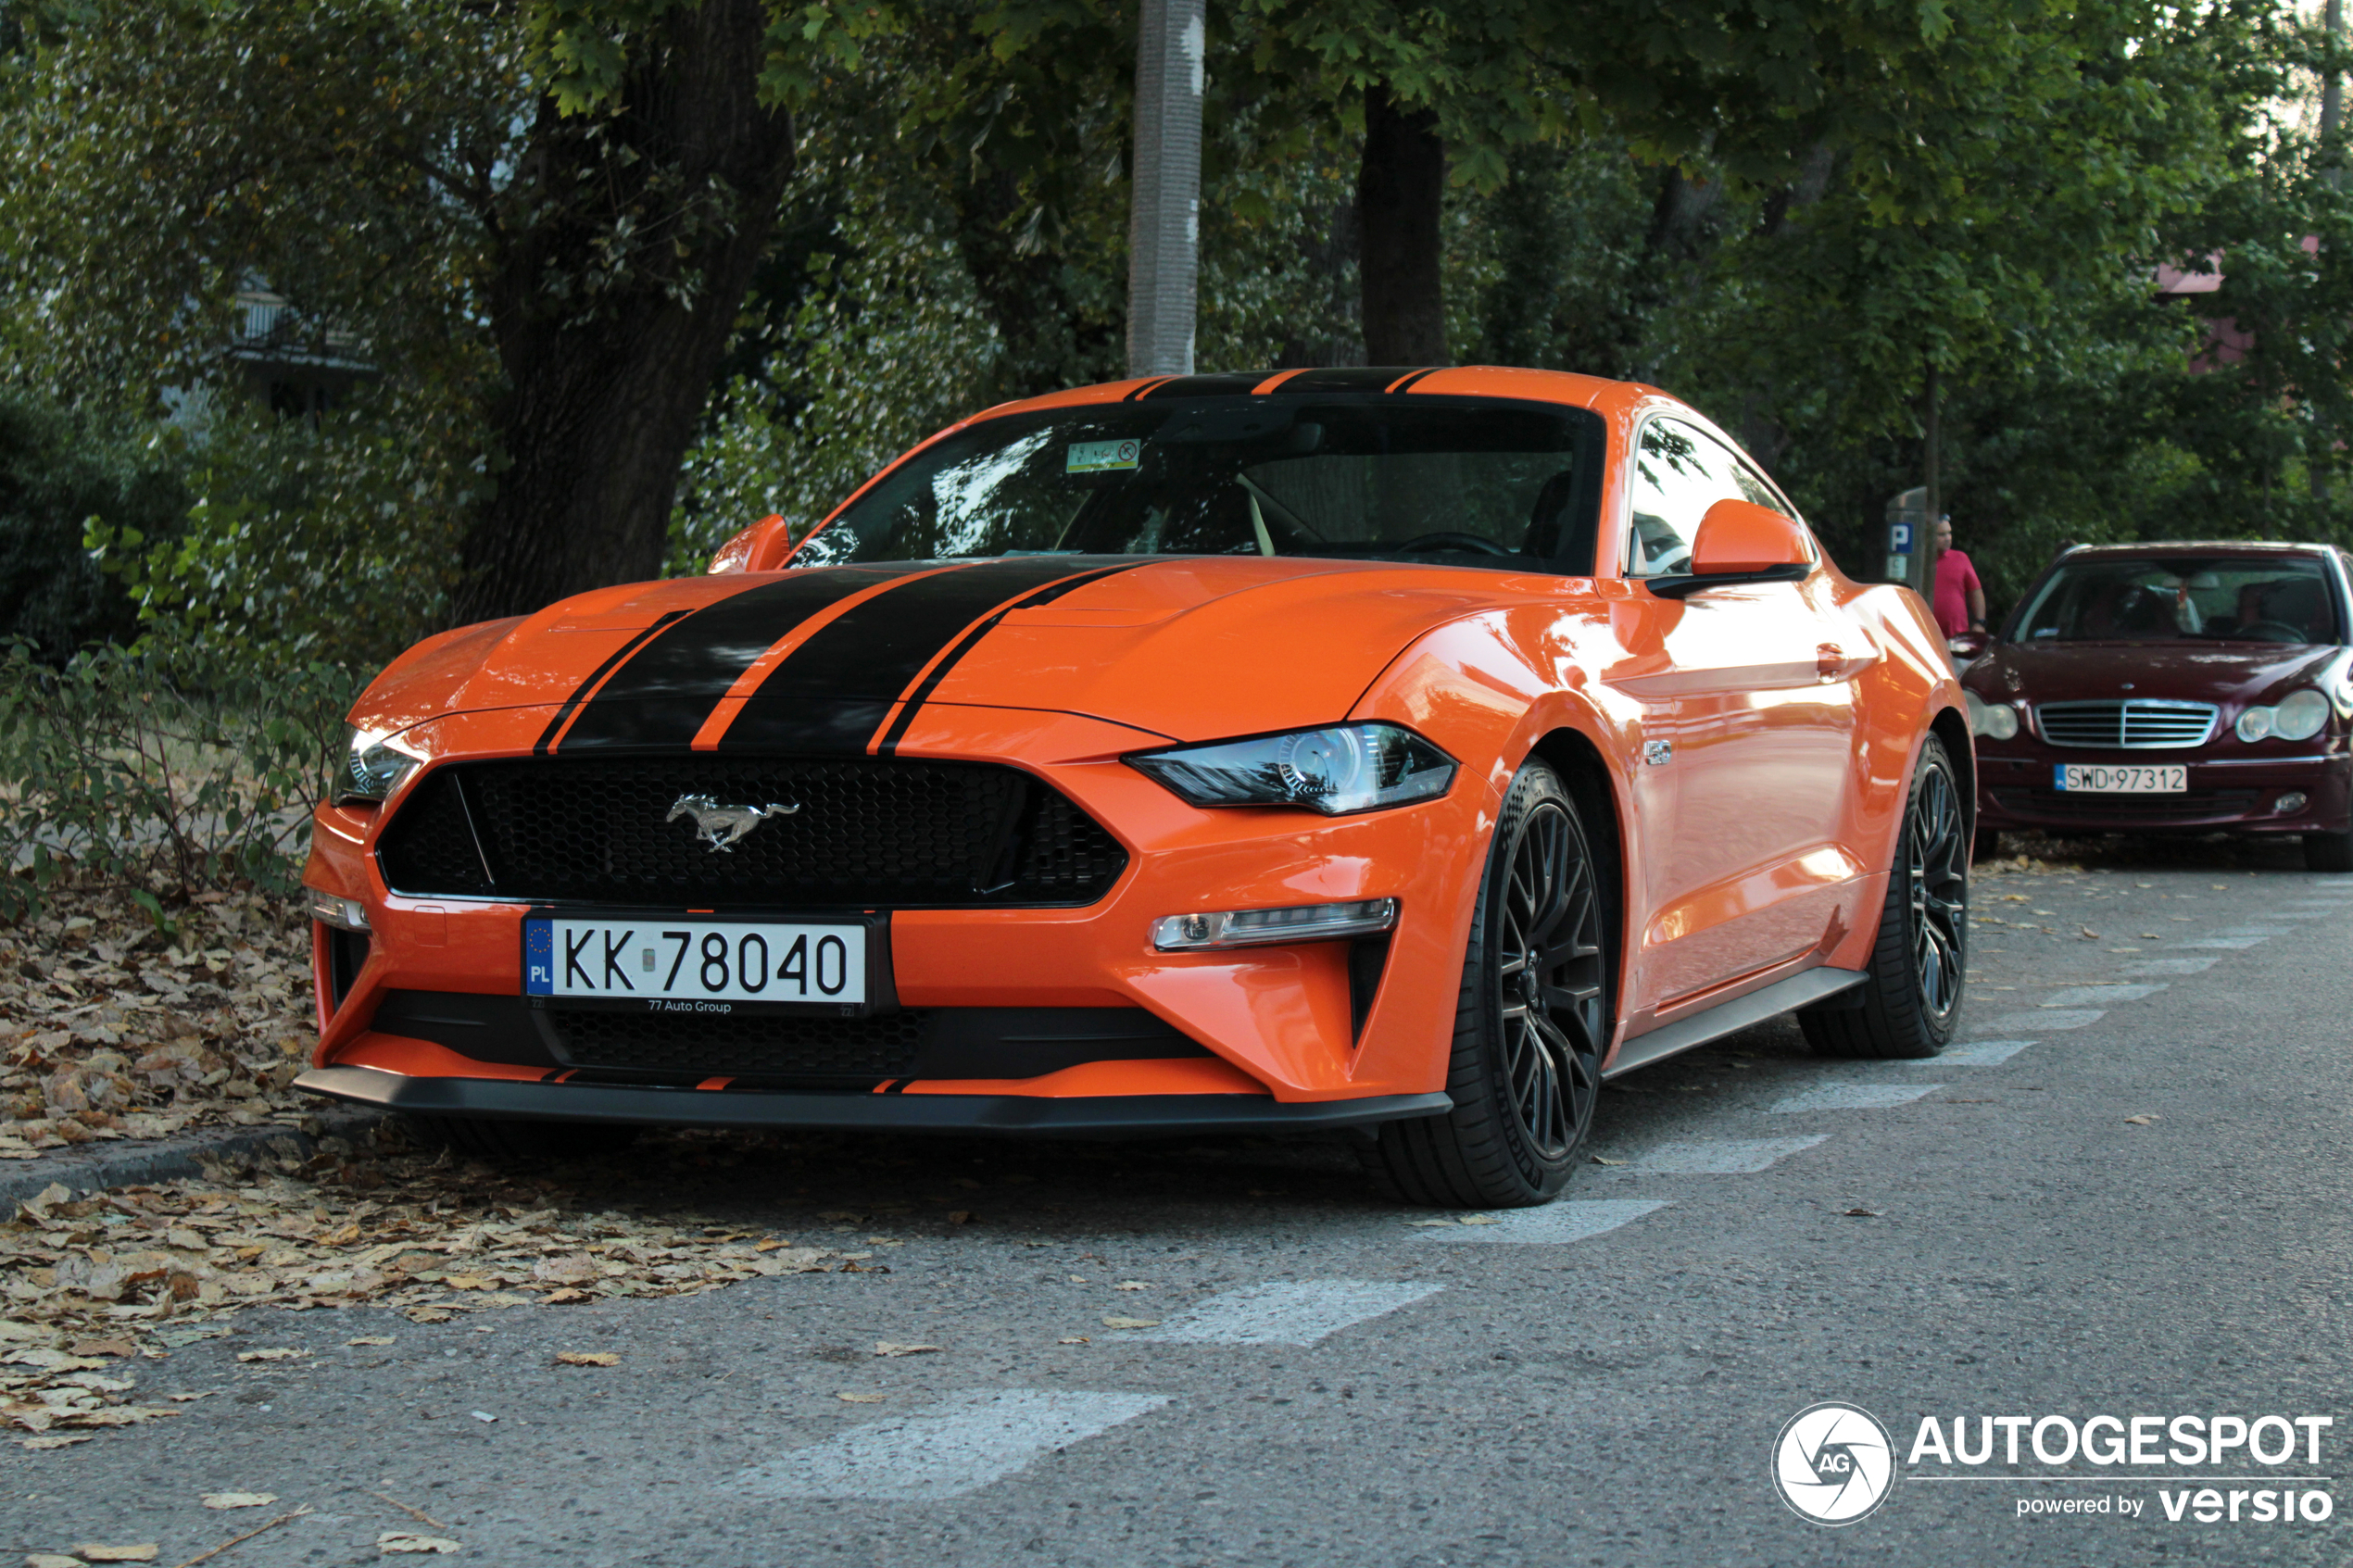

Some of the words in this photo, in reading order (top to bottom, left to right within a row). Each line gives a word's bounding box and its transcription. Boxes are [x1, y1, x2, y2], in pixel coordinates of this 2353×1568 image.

[1892, 525, 1908, 552] P
[2067, 768, 2108, 789] SWD
[2116, 768, 2184, 790] 97312
[565, 928, 635, 990] KK
[661, 931, 847, 996] 78040
[530, 965, 550, 984] PL
[648, 999, 662, 1011] 77
[664, 1000, 693, 1011] Auto
[695, 1000, 732, 1015] Group
[1492, 1071, 1532, 1174] MICHELIN
